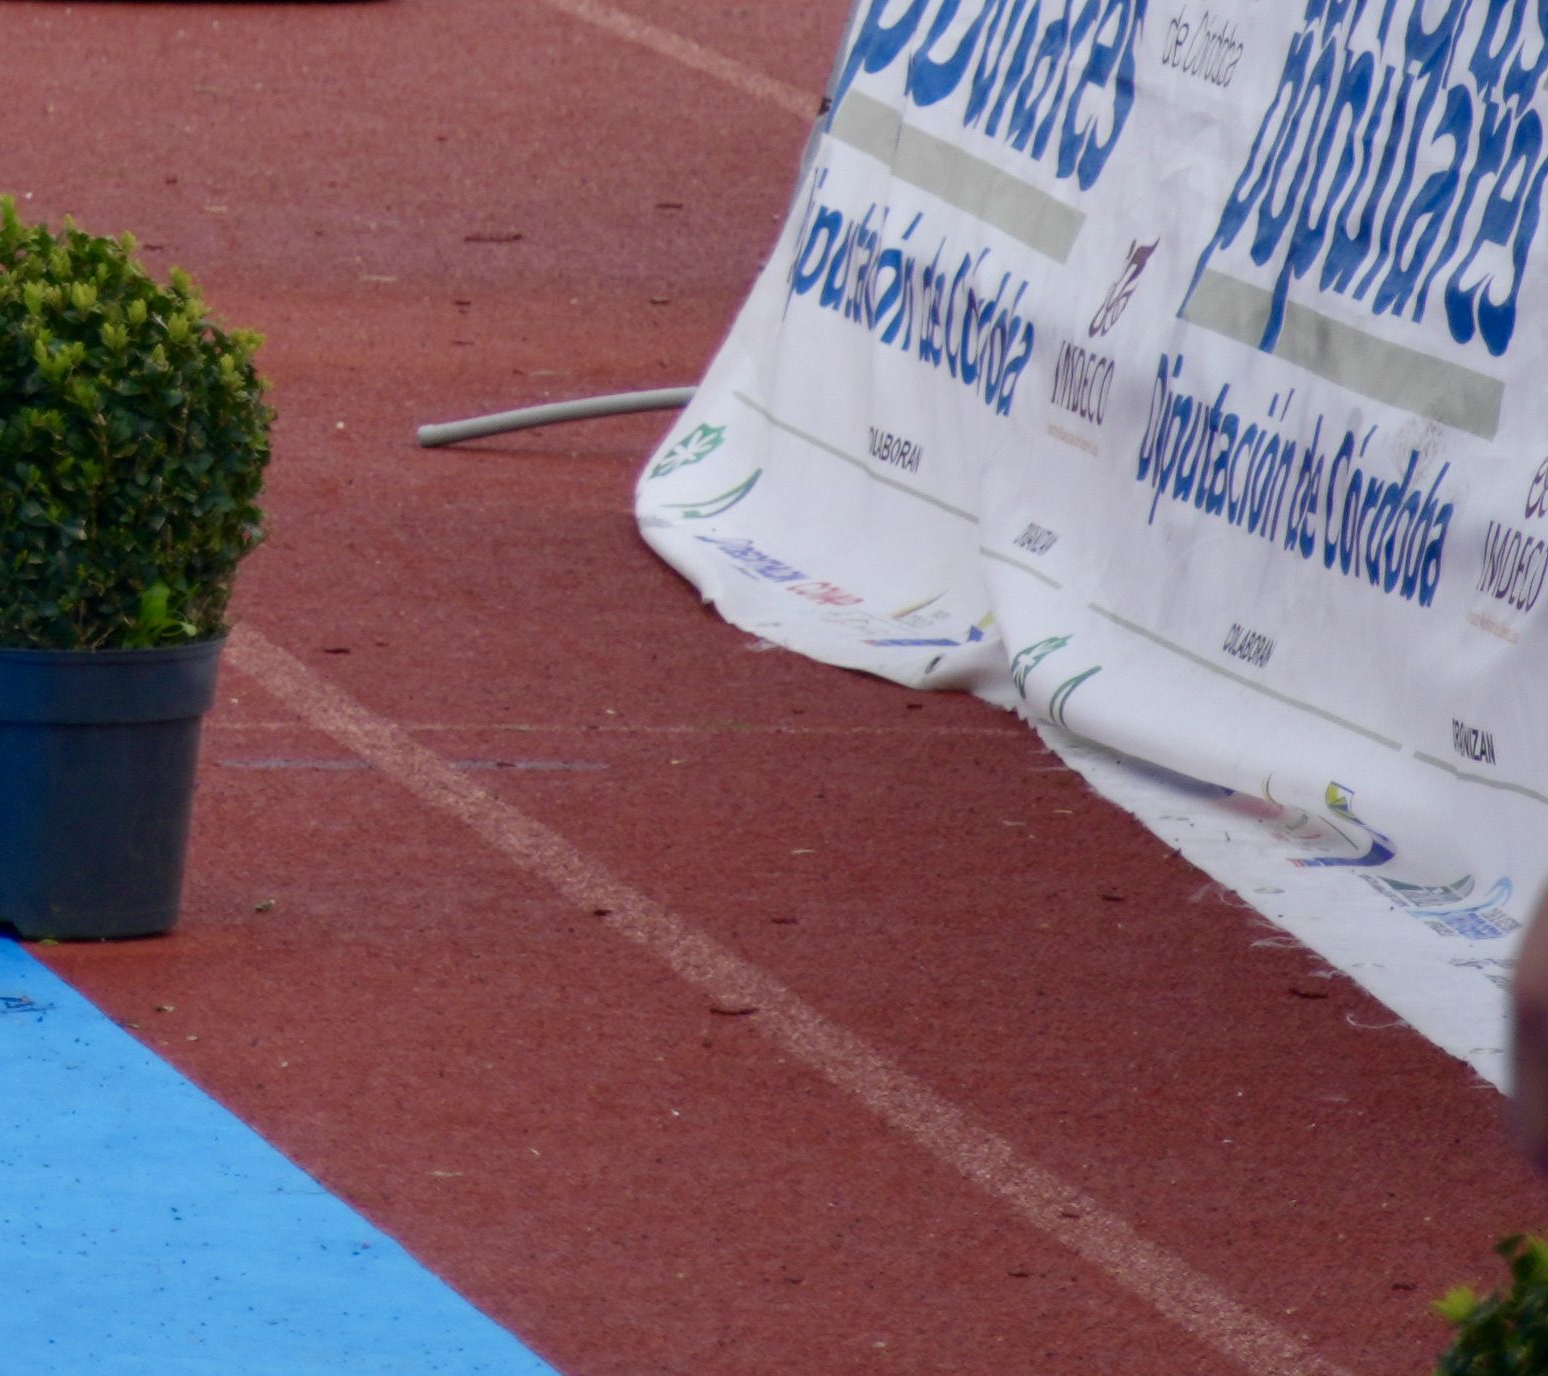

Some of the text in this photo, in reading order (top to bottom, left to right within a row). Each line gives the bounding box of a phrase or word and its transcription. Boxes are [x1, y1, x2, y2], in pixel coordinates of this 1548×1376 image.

[869, 426, 925, 473] LABORAN
[1136, 353, 1454, 609] Diputación de Córdoba
